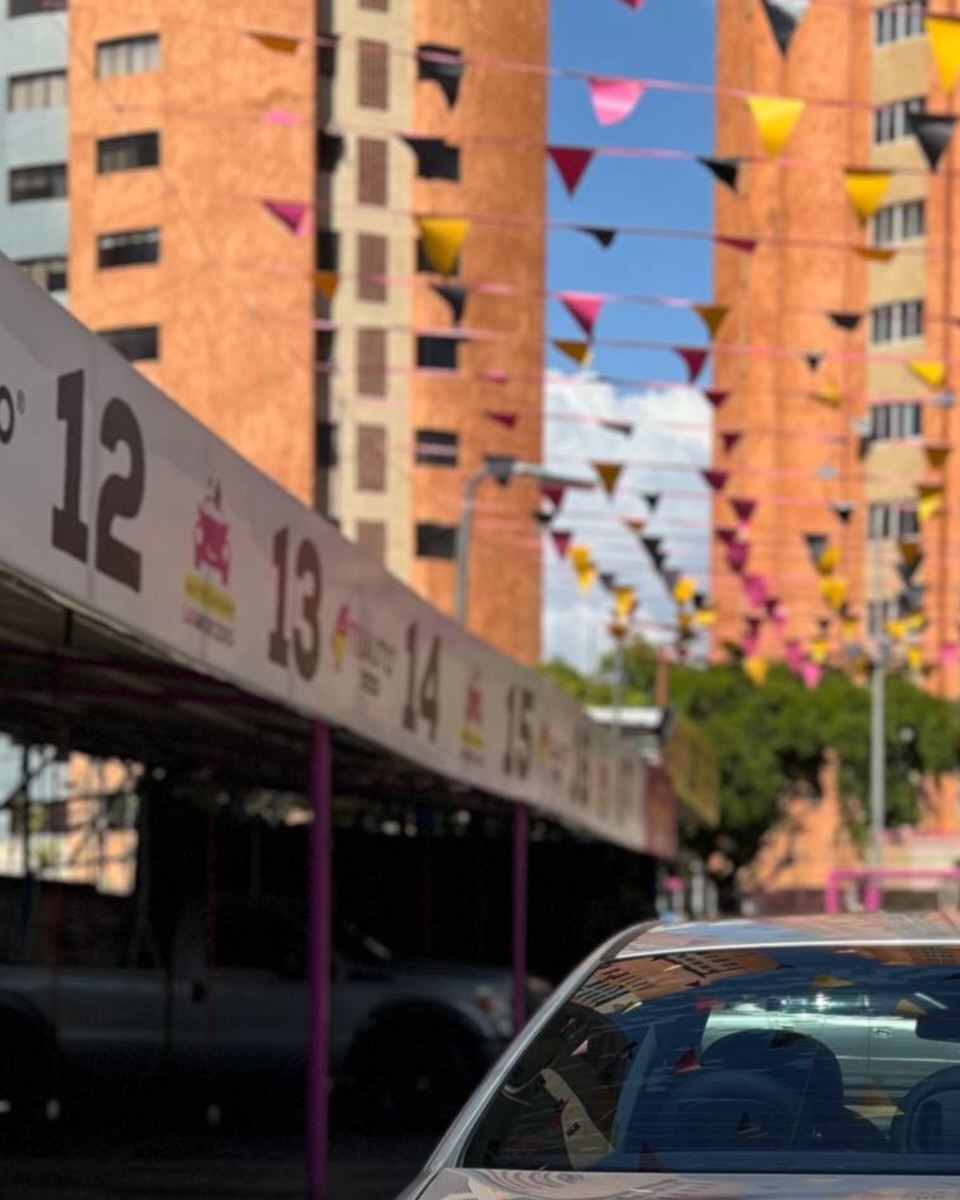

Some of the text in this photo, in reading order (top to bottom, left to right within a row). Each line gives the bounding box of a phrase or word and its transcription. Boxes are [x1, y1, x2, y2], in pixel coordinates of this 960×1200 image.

[51, 368, 146, 594] 12
[267, 524, 323, 683] 13
[402, 620, 441, 744] 14
[503, 684, 535, 781] 15
